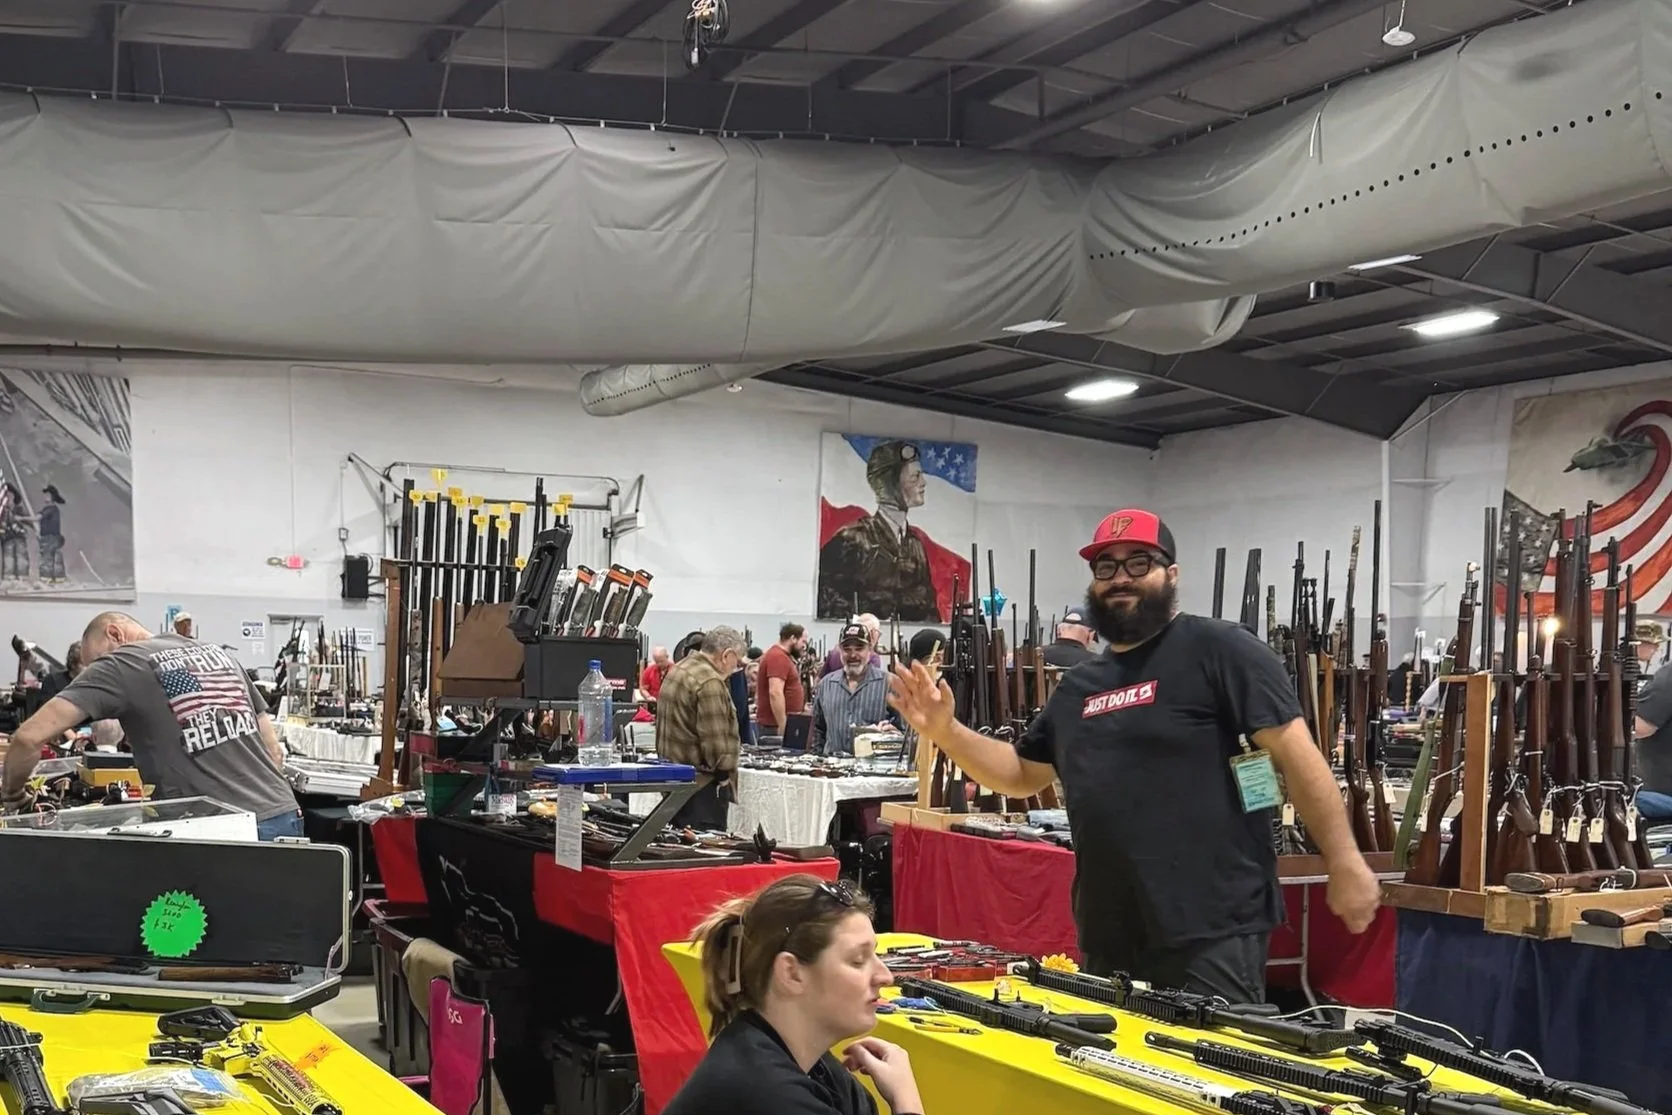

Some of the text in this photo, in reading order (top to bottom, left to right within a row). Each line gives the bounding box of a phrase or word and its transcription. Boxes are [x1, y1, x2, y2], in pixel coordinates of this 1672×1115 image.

[149, 648, 185, 663] THESE
[192, 646, 236, 674] RUN
[1084, 696, 1109, 714] JUST
[1107, 692, 1126, 708] DO
[186, 708, 218, 727] THEY
[182, 713, 258, 753] RELOAD
